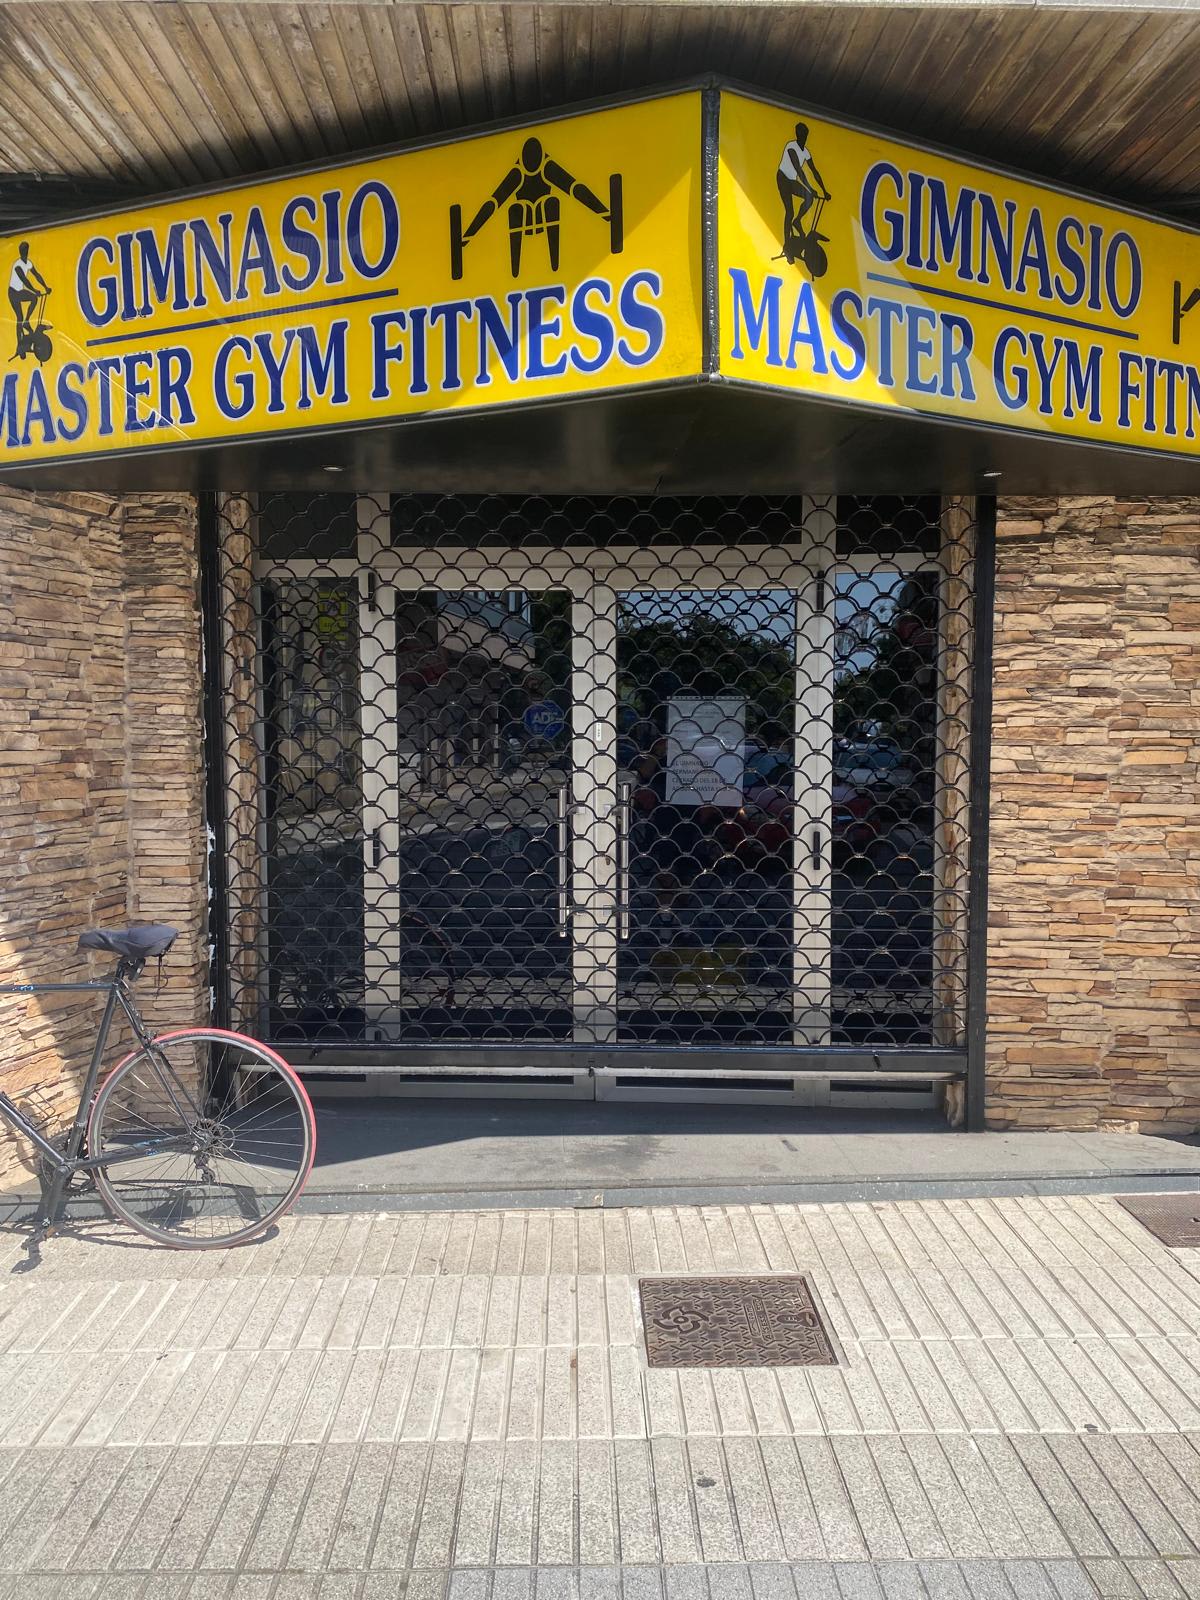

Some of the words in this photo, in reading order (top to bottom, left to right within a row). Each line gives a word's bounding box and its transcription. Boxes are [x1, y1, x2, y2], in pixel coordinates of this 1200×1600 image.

[78, 181, 400, 328] GIMNASIO
[860, 162, 1142, 319] GIMNASIO
[213, 321, 350, 420] GYM
[371, 271, 664, 400] FITNESS
[728, 268, 977, 402] MASTER
[992, 326, 1104, 423] GYM
